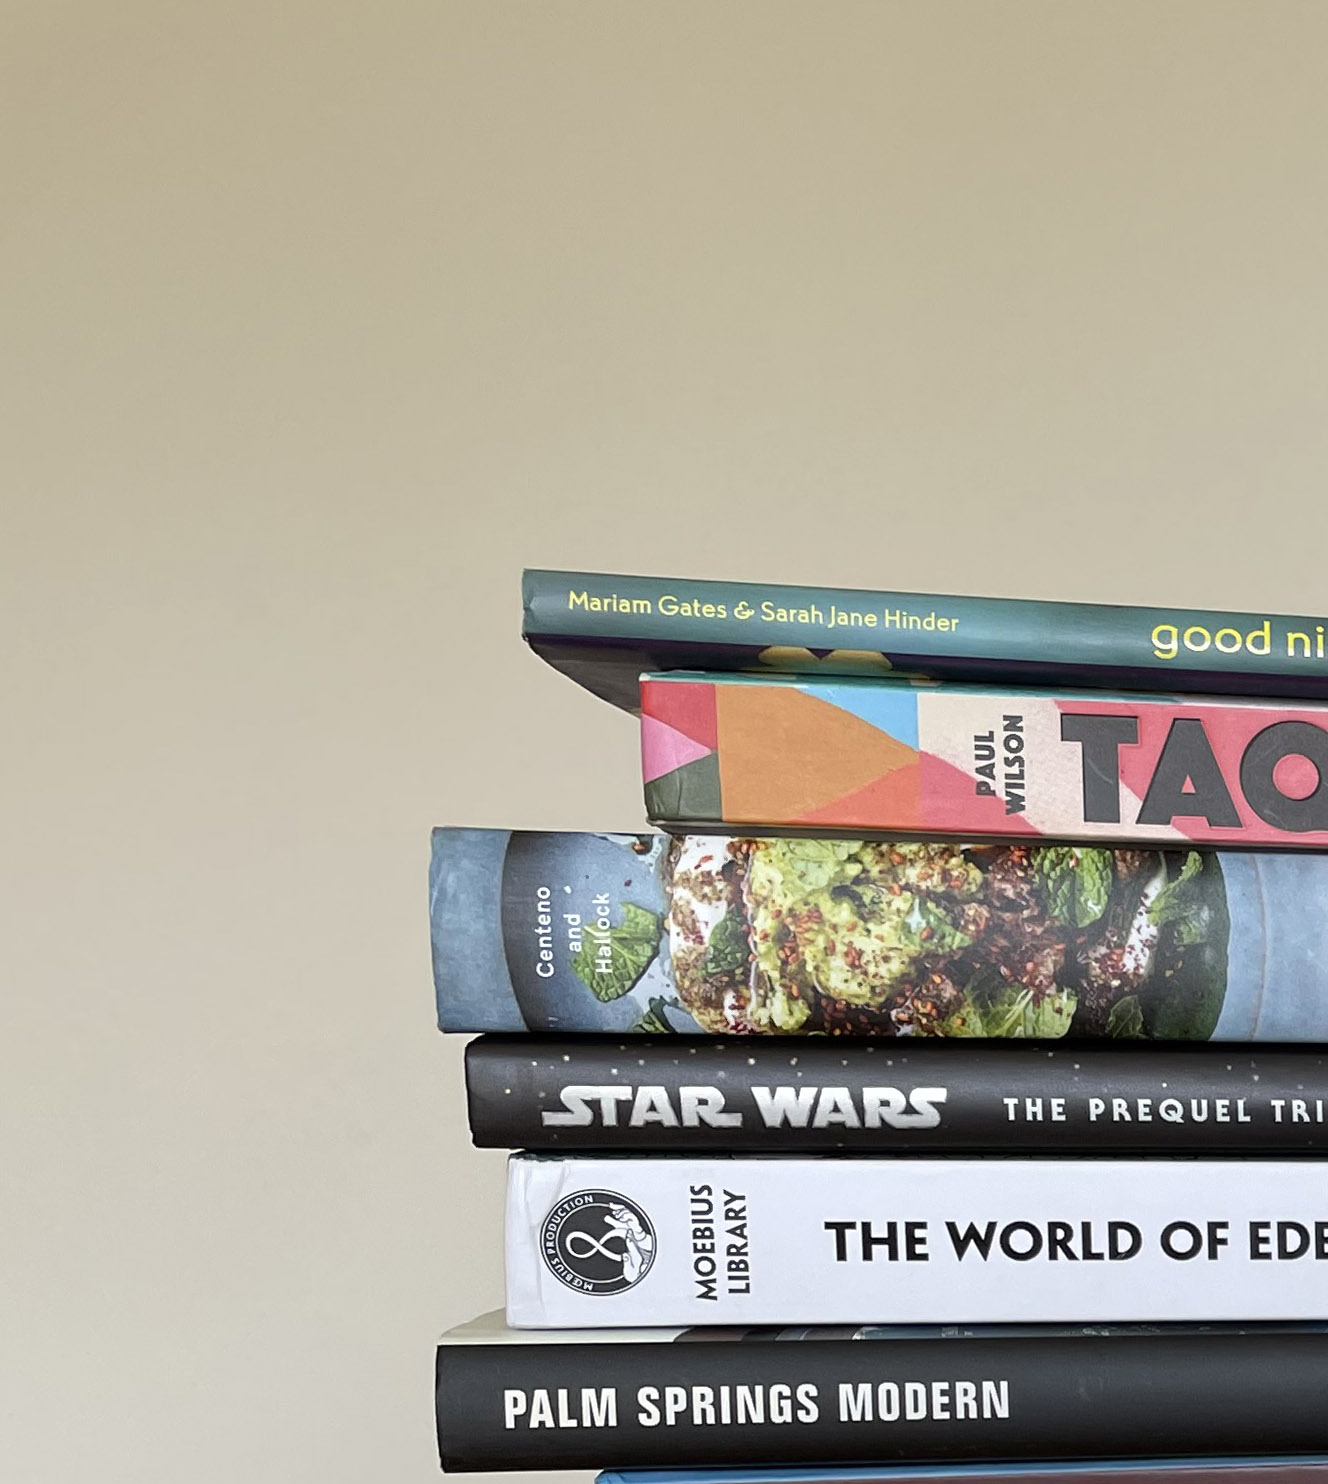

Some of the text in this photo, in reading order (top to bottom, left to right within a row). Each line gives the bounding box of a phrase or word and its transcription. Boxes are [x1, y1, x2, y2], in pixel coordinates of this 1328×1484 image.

[568, 590, 960, 632] Mariam Gates & Sarah Jane Hinder
[1150, 621, 1271, 660] good
[973, 730, 997, 797] PAUL
[1002, 714, 1026, 816] WILSON
[534, 886, 554, 978] Centeno
[563, 913, 582, 953] and
[592, 892, 613, 974] Hallock
[541, 1085, 948, 1130] STAR WARS
[1003, 1097, 1067, 1123] THE
[1088, 1097, 1253, 1125] PREQUEL
[545, 1194, 594, 1255] PRODUCTION
[689, 1185, 718, 1301] MOEBIUS
[722, 1188, 750, 1294] LIBRARY
[824, 1219, 929, 1262] THE
[945, 1220, 1144, 1262] WORLD
[1159, 1219, 1231, 1262] OF
[502, 1379, 1010, 1429] PALM SPRINGS MODERN
